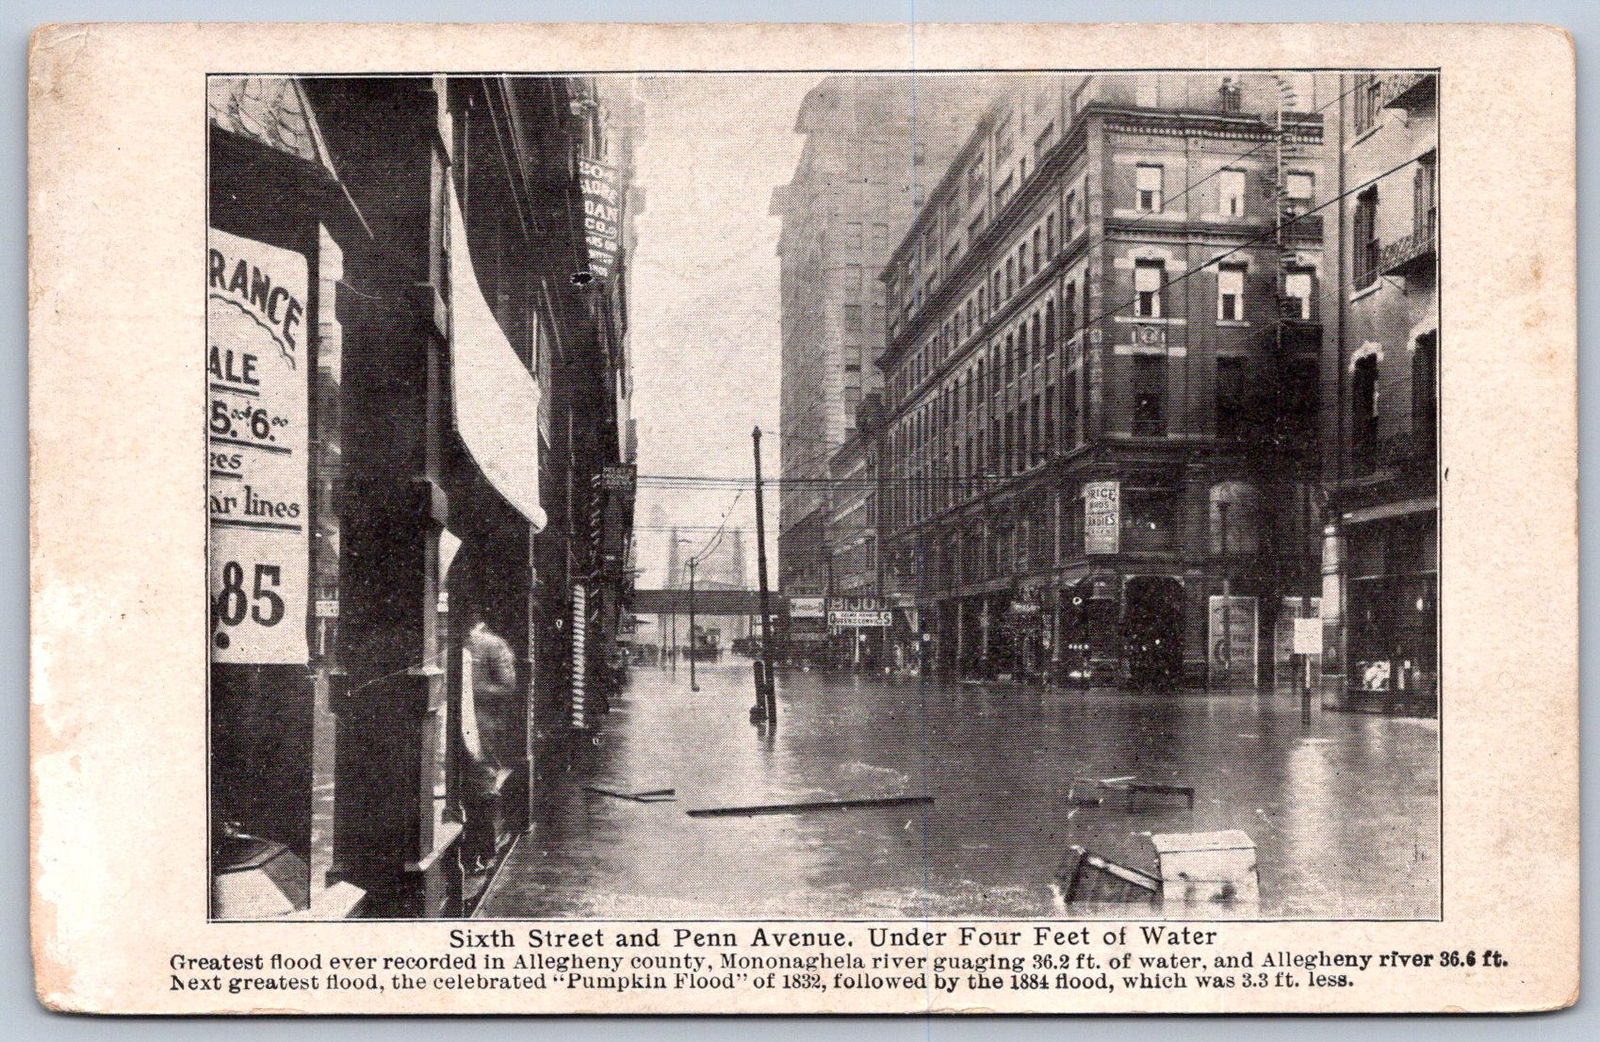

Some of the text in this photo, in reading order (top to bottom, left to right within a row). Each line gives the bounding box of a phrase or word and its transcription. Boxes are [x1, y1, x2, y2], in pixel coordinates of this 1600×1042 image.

[210, 248, 303, 351] RANCE
[210, 346, 259, 386] ALE
[244, 485, 300, 518] lines
